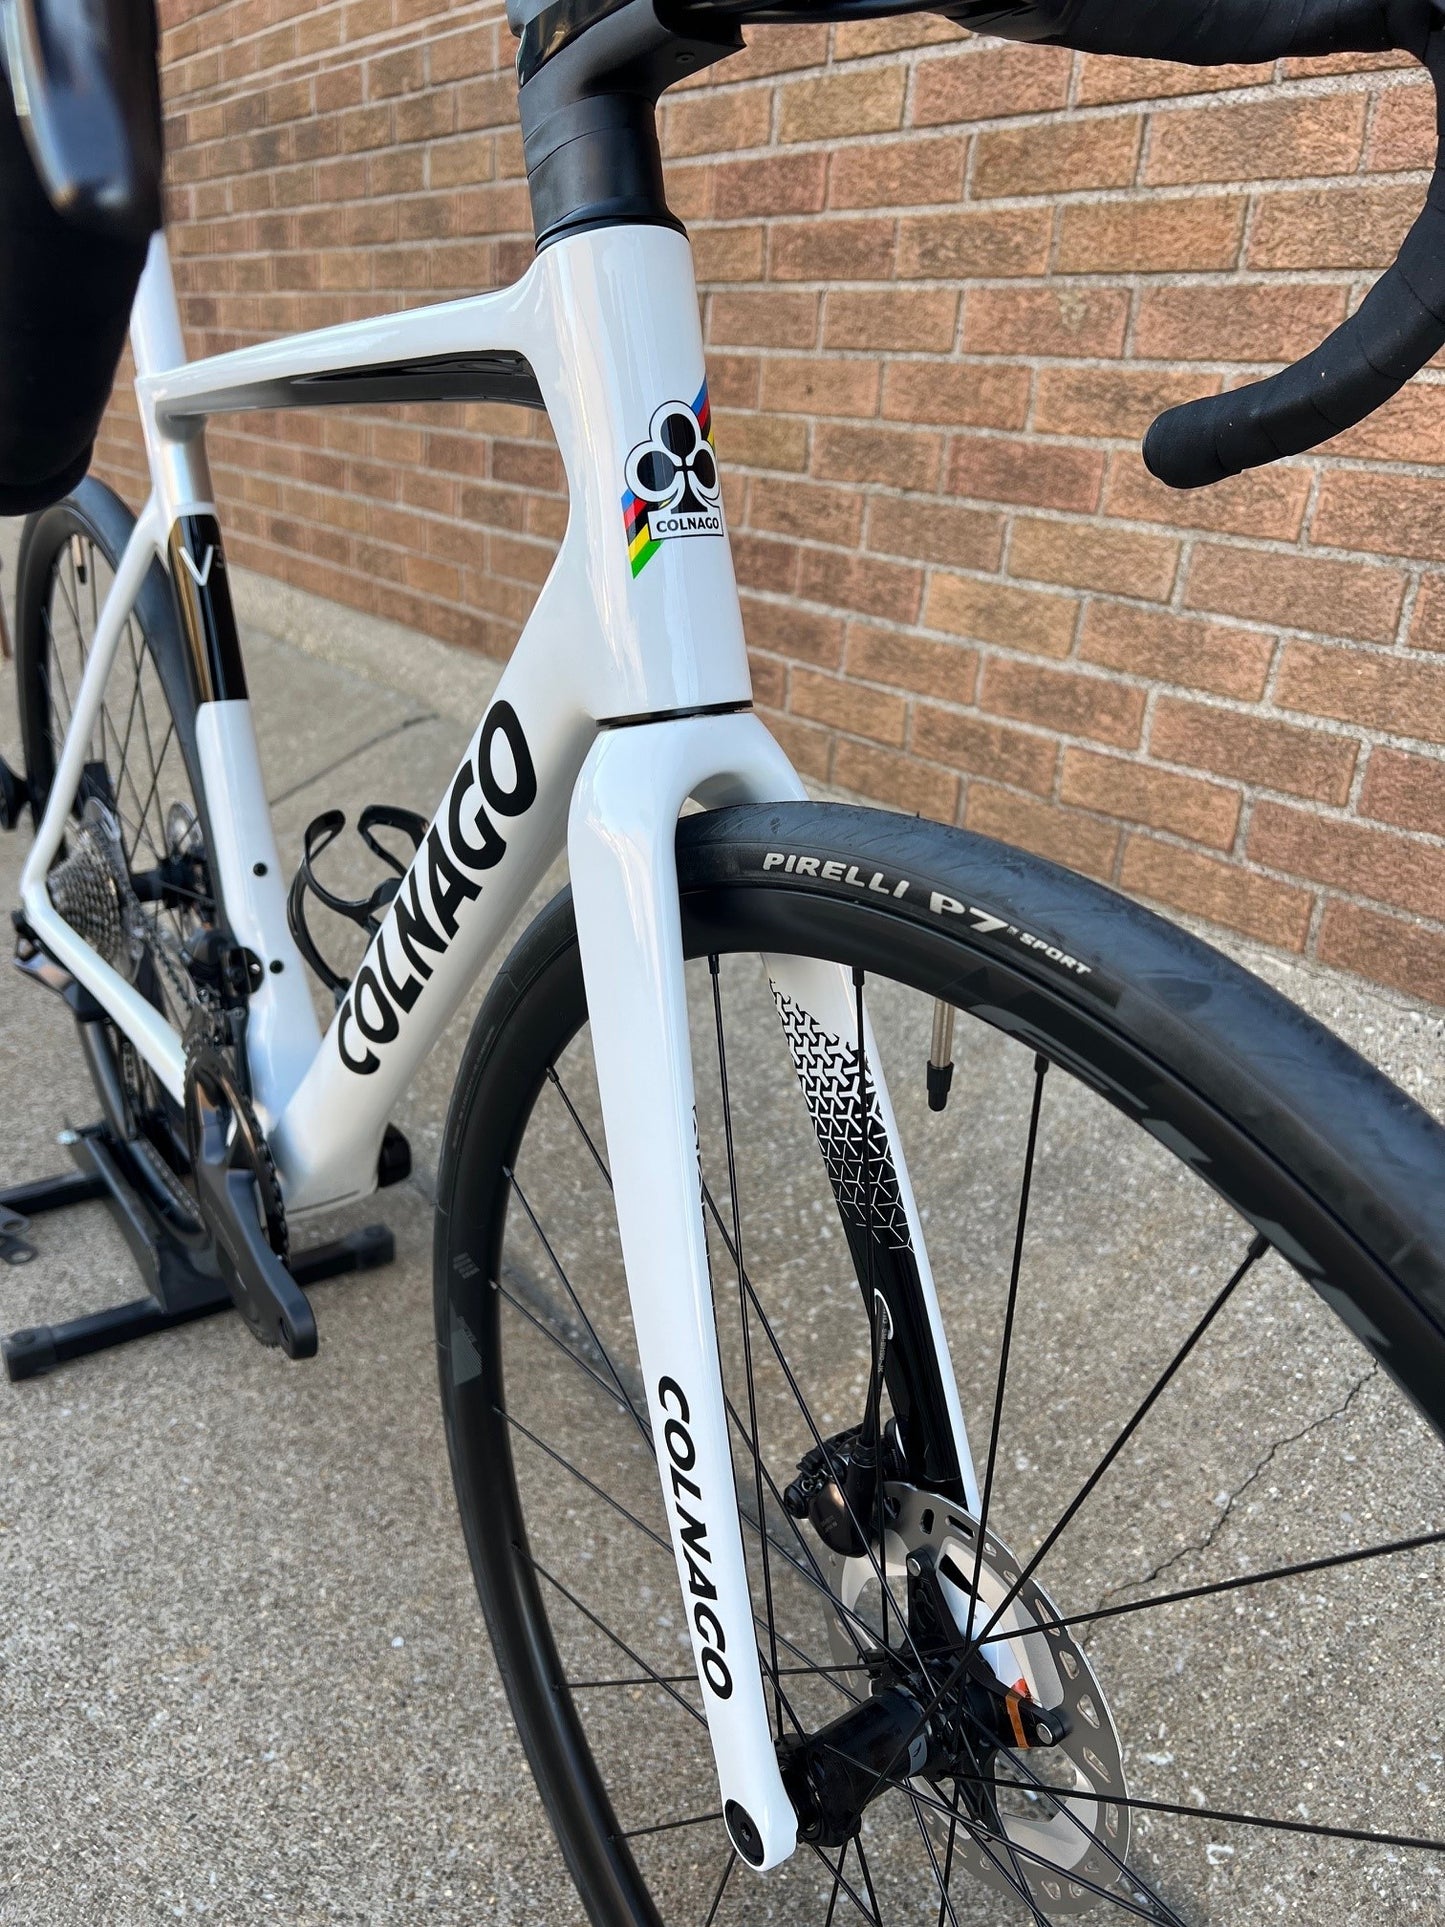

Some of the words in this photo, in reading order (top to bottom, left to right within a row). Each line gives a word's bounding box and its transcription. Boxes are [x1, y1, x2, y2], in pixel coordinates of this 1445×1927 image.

[656, 516, 719, 533] COLNAGO
[338, 700, 537, 1075] COLNAGO
[762, 852, 910, 899] PIRELLI
[1019, 932, 1092, 974] SPORT
[658, 1376, 733, 1700] COLNAGO
